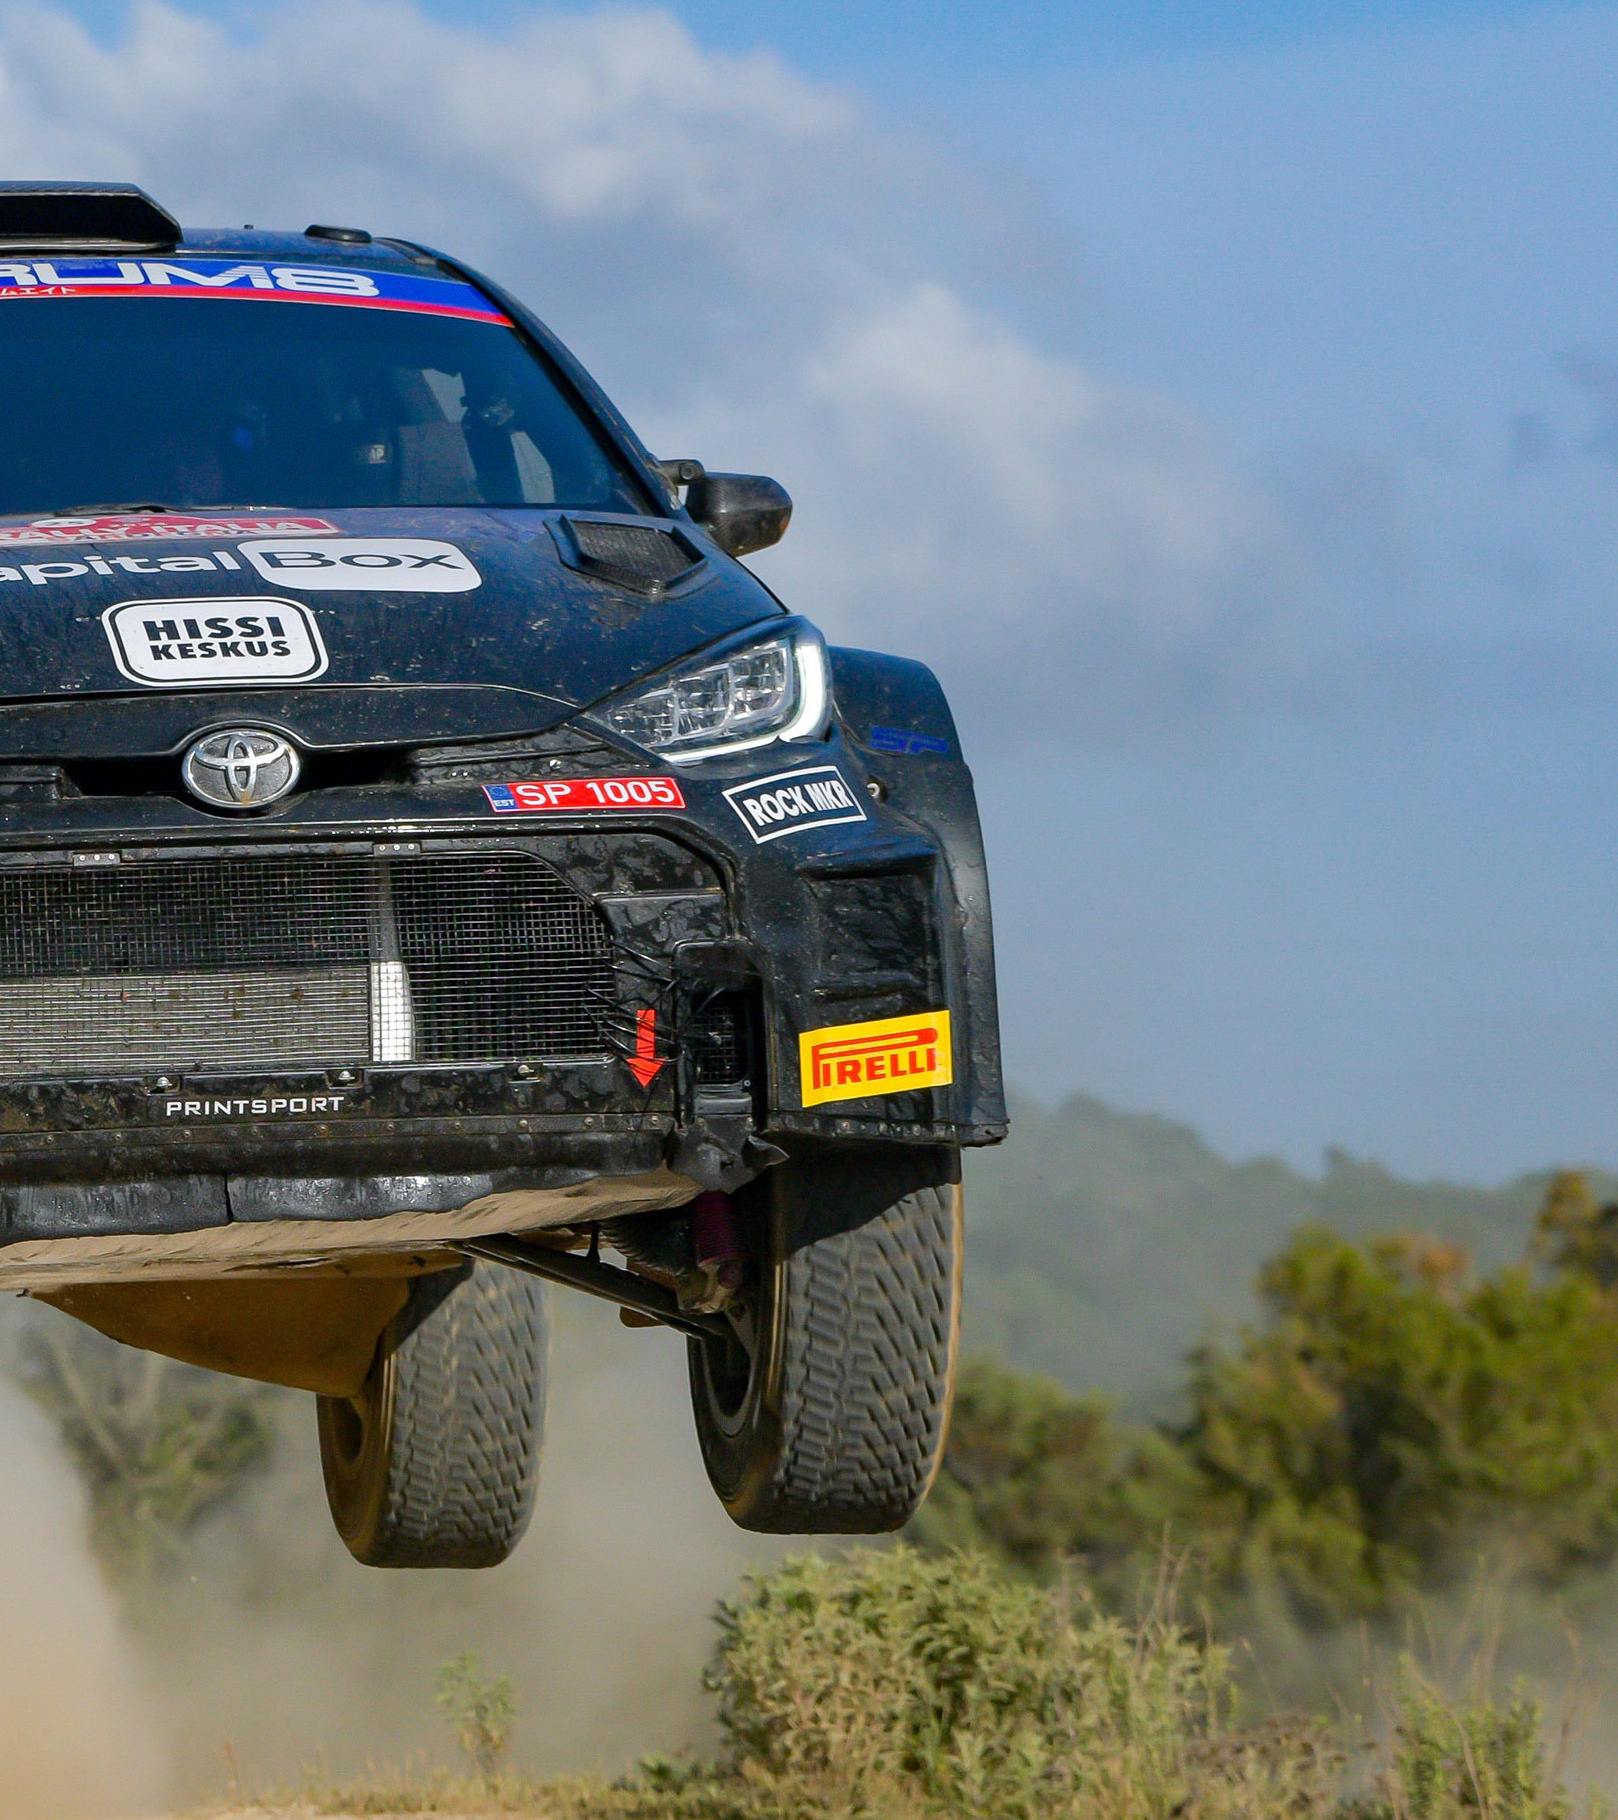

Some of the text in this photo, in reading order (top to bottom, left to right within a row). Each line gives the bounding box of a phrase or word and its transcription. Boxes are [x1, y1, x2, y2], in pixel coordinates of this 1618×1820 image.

[150, 522, 307, 535] ITALIA
[257, 551, 465, 570] Box
[142, 616, 286, 641] HISSI
[149, 640, 292, 661] KESKUS
[515, 780, 675, 806] SP 1005
[742, 779, 855, 826] ROCK MKR
[811, 1027, 939, 1090] PIRELLI
[166, 1096, 345, 1117] PRINTSPORT
